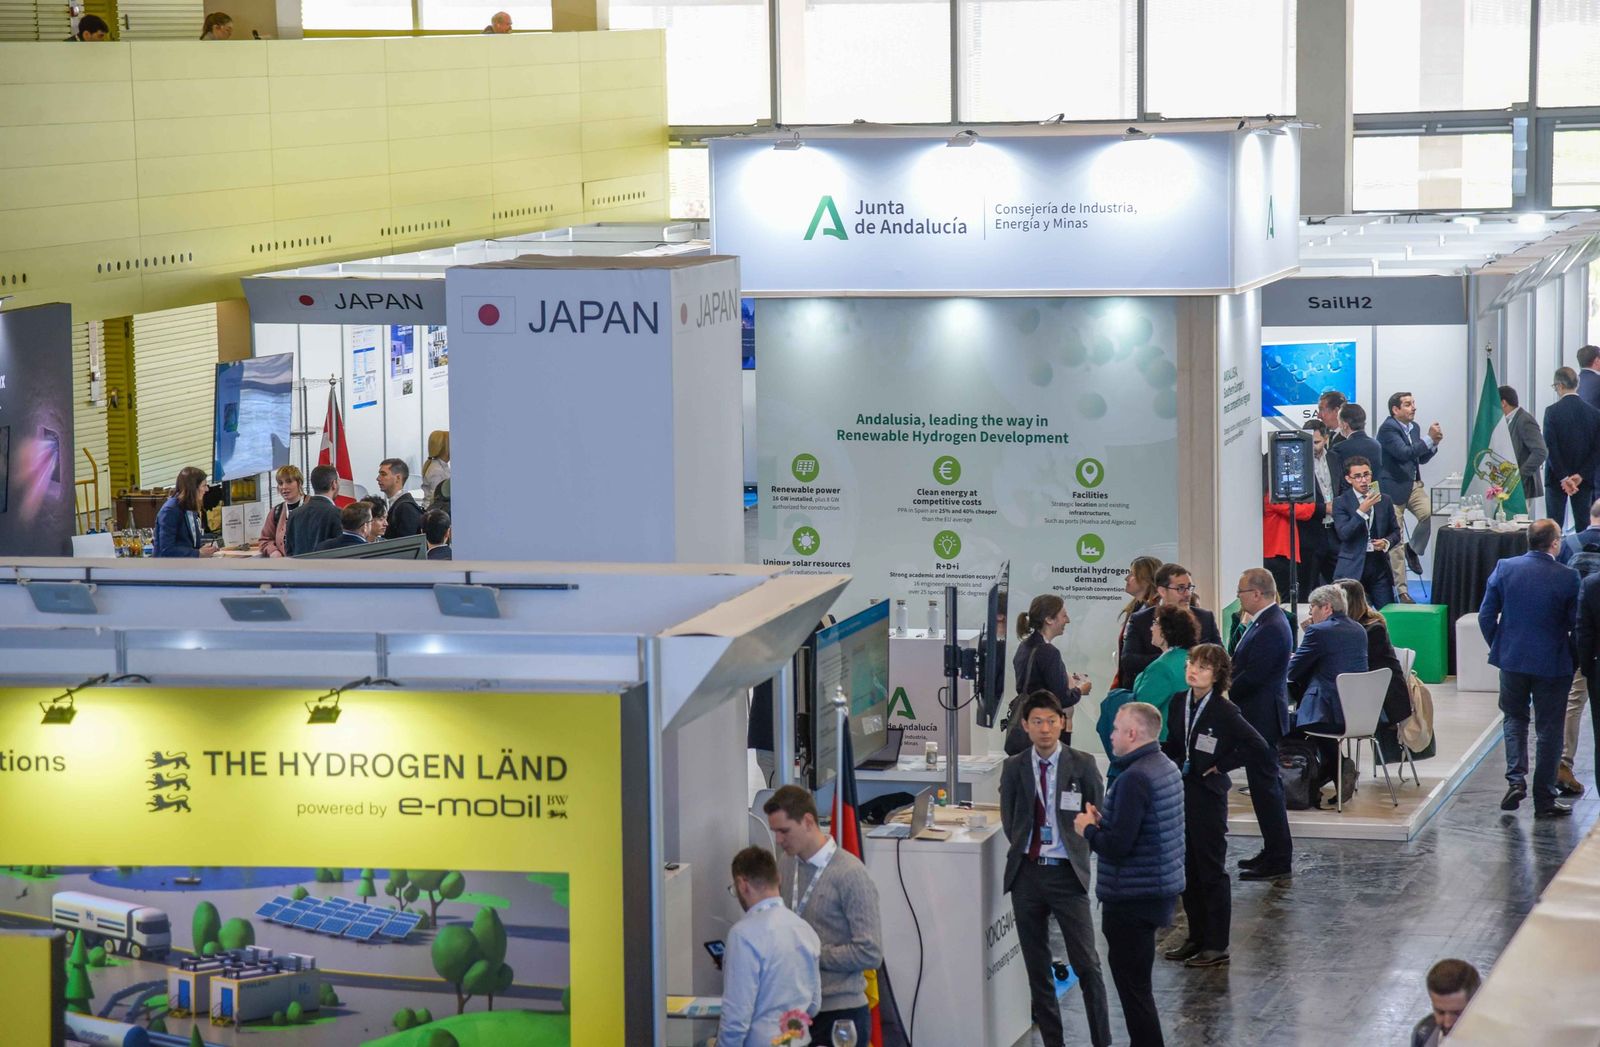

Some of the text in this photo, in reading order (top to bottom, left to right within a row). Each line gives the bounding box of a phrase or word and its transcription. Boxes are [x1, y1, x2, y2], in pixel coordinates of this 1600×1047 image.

[855, 200, 904, 215] Junta
[995, 202, 1138, 216] Consejería de Industria,
[854, 216, 967, 234] de Andalucía
[995, 216, 1088, 232] Energía y Minas
[334, 293, 424, 310] JAPAN
[696, 288, 738, 328] JAPAN
[1308, 296, 1372, 309] SailH2
[528, 300, 659, 334] JAPAN
[856, 414, 1048, 430] Andalusia, leading the way in
[1302, 410, 1319, 418] SA
[836, 430, 1069, 446] Renewable Hydrogen Development
[771, 486, 814, 494] Renewable
[1072, 491, 1108, 499] Facilities
[912, 498, 960, 506] competitive
[1092, 566, 1131, 576] hydrogen
[899, 722, 938, 732] Andalucía
[0, 750, 66, 772] tions
[203, 748, 568, 782] THE HYDROGEN LÄND
[297, 794, 568, 818] powered by e-mobil BW
